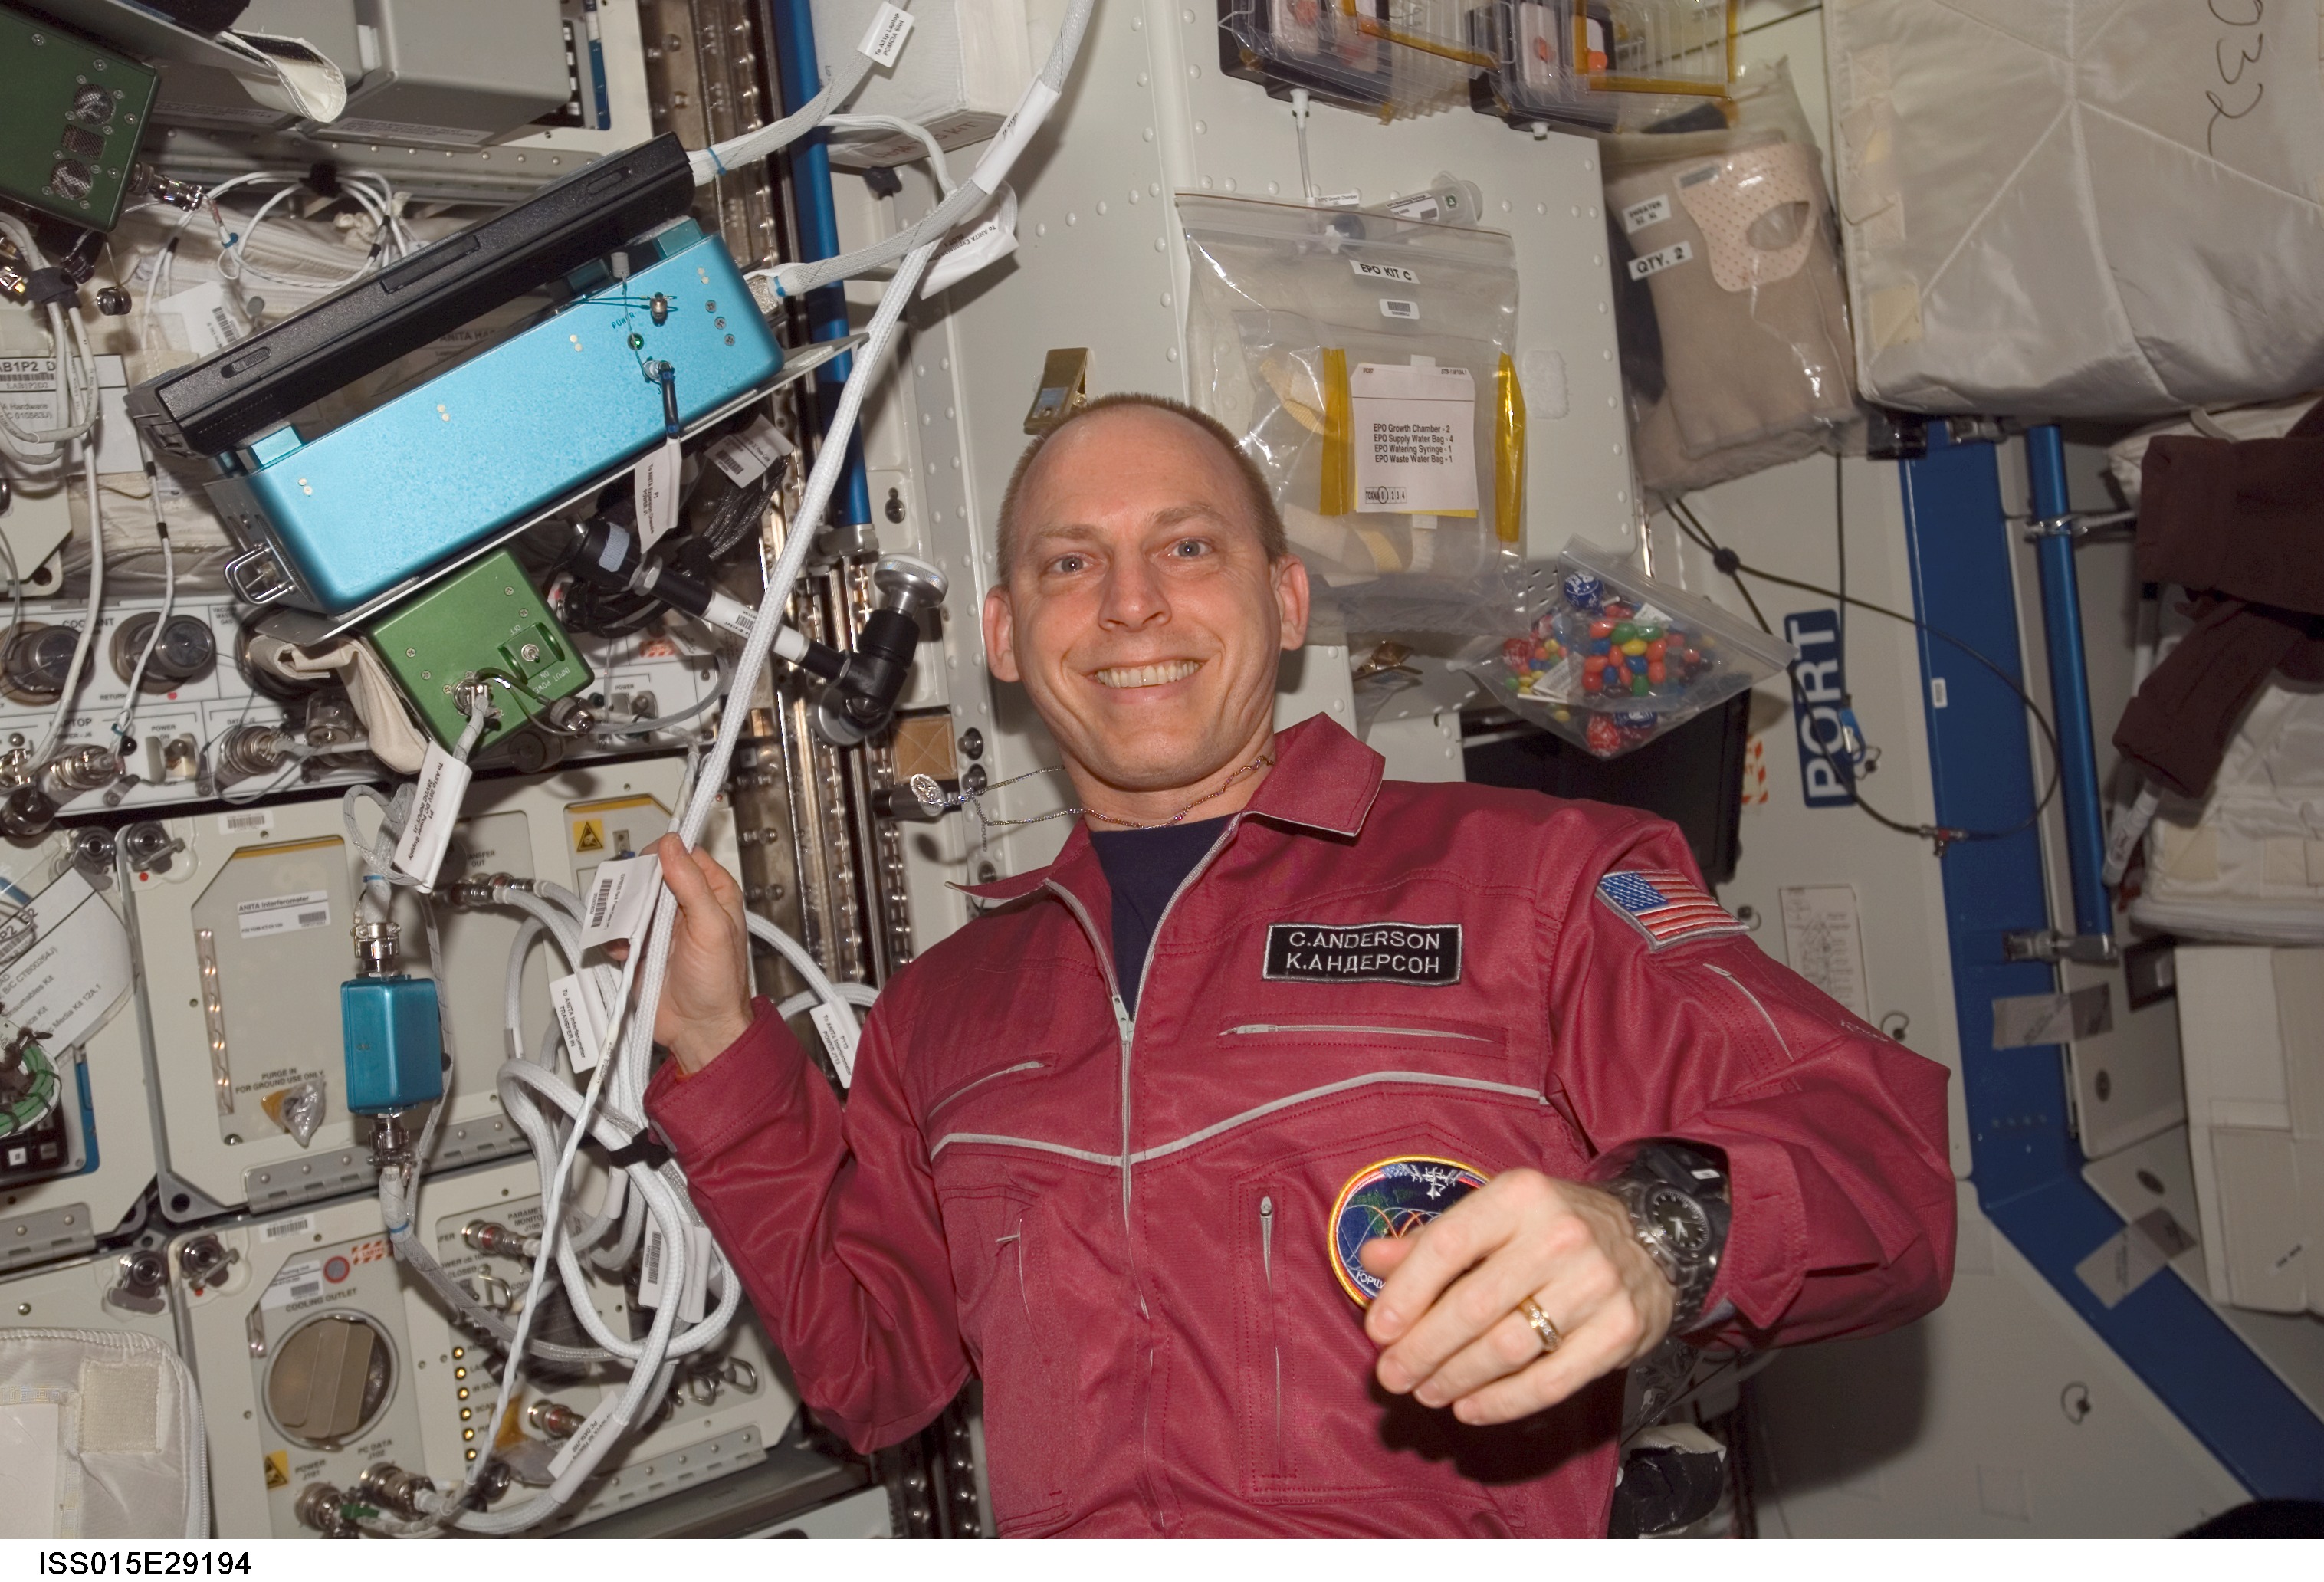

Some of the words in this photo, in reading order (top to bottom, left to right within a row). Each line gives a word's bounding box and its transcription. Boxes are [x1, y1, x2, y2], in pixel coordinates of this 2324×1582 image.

[1637, 253, 1670, 273] QTY.
[1674, 247, 1685, 260] 2
[1359, 264, 1380, 274] EPO
[1384, 267, 1400, 279] KIT
[1403, 271, 1412, 281] C
[1374, 423, 1387, 432] EPO
[1388, 424, 1411, 432] Growth
[1412, 425, 1441, 433] Chamber
[1374, 434, 1387, 442] EPO
[1388, 435, 1410, 445] Supply
[1412, 435, 1430, 443] Water
[1431, 435, 1445, 445] Bag
[1389, 445, 1417, 455] Watering
[1418, 445, 1443, 455] Syringe
[1375, 455, 1388, 463] EPO
[1390, 455, 1409, 463] Waste
[1431, 455, 1444, 464] Bag
[62, 618, 115, 628] COOANT
[510, 624, 521, 635] OFF
[540, 671, 550, 679] ON
[553, 667, 571, 682] INPUT
[533, 681, 552, 694] POWE
[1789, 619, 1849, 797] PORT
[436, 762, 443, 771] To
[429, 809, 435, 819] P1
[409, 836, 420, 860] Supply
[261, 896, 309, 908] Interferometer
[1289, 931, 1439, 950] C.ANDERSON
[1286, 953, 1439, 974] К.АНДЕРСОН
[42, 975, 54, 985] Kit
[563, 988, 568, 996] To
[37, 1006, 48, 1016] Kit
[52, 1010, 74, 1028] Media
[72, 1000, 84, 1011] Kit
[83, 983, 101, 1001] 12A.1
[565, 998, 573, 1016] ANITA
[560, 1005, 573, 1039] TRANSFER
[826, 1022, 836, 1039] ANITA
[570, 1016, 586, 1058] Interferometer
[822, 1030, 835, 1051] POWER
[261, 1068, 287, 1080] PURGE
[235, 1085, 251, 1094] FOR
[253, 1078, 285, 1090] GROUND
[287, 1075, 302, 1084] USE
[304, 1070, 323, 1080] ONLY
[507, 1207, 542, 1219] PARAMET
[514, 1214, 543, 1226] MONITO
[286, 1296, 323, 1312] COOLING
[325, 1288, 357, 1302] OUTLET
[371, 1439, 392, 1450] DATA
[294, 1459, 326, 1473] POWER
